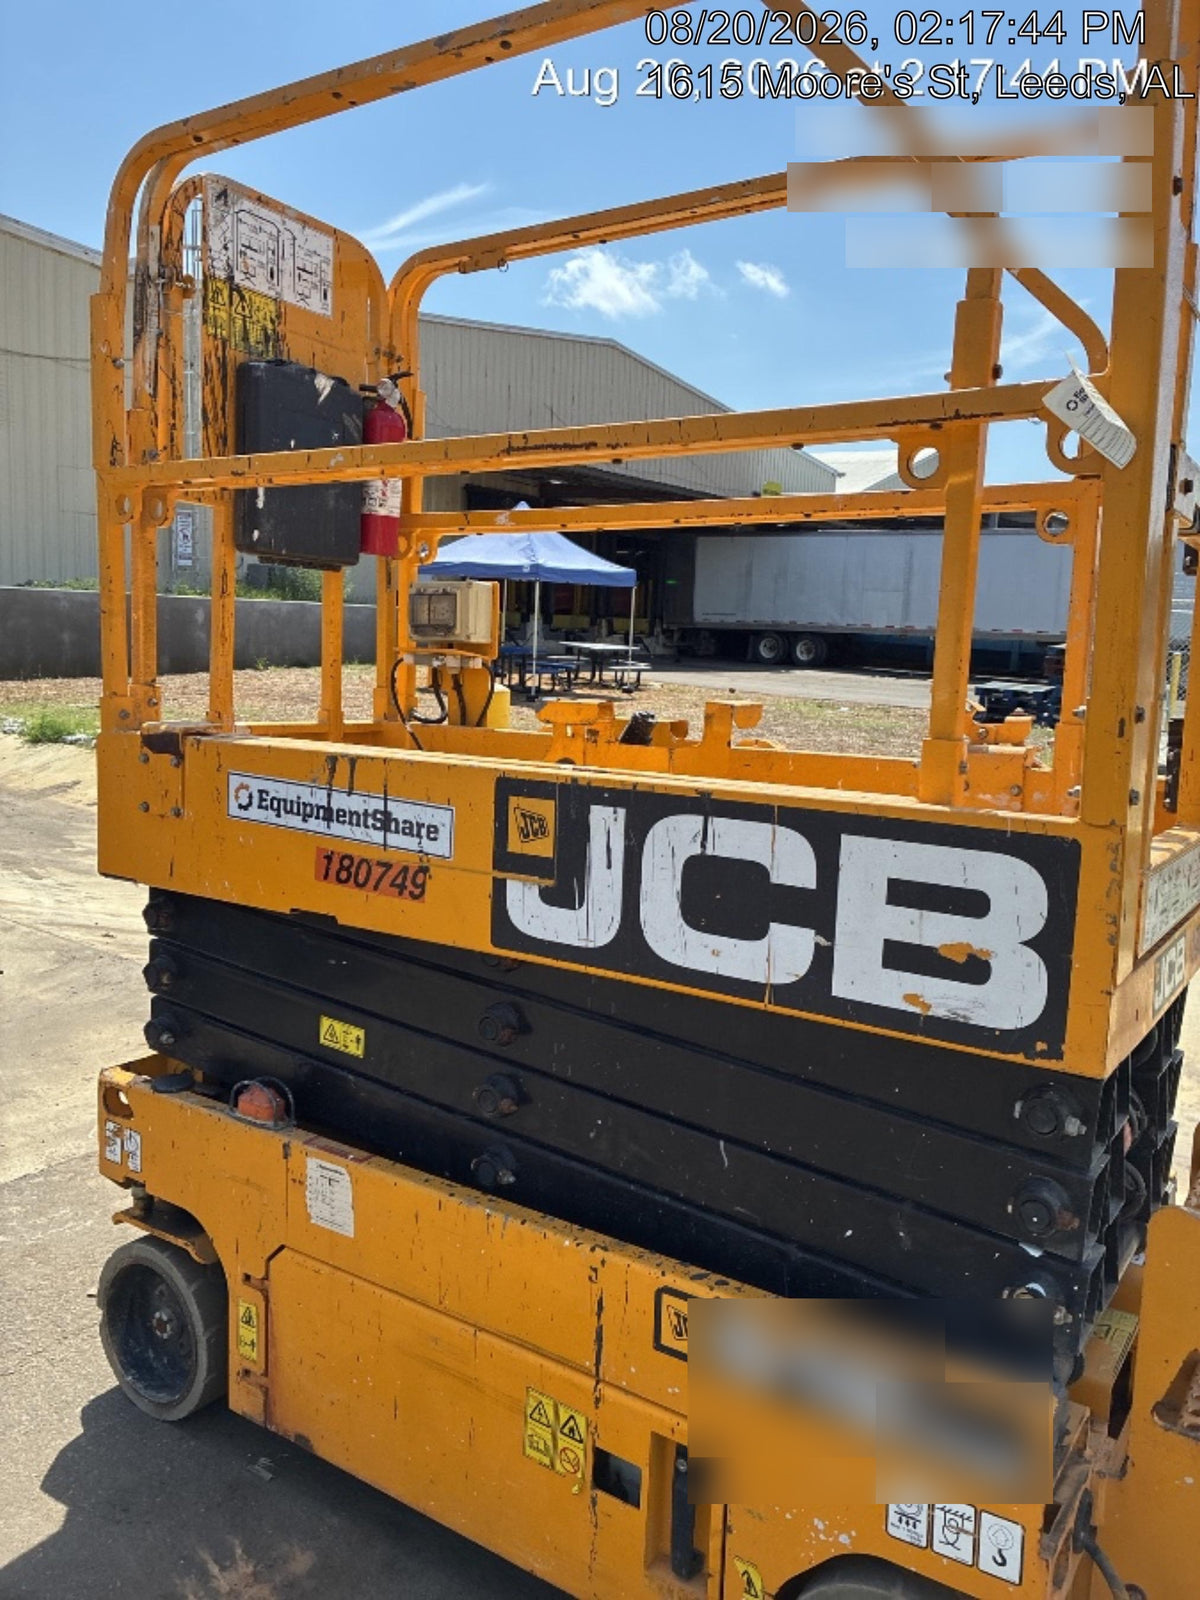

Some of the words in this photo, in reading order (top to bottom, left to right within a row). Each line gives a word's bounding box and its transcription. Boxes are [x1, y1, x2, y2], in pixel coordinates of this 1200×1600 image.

[256, 788, 440, 842] EquipmentShare
[519, 811, 549, 839] JCB
[321, 852, 431, 901] 180749
[506, 804, 1049, 1031] JCB
